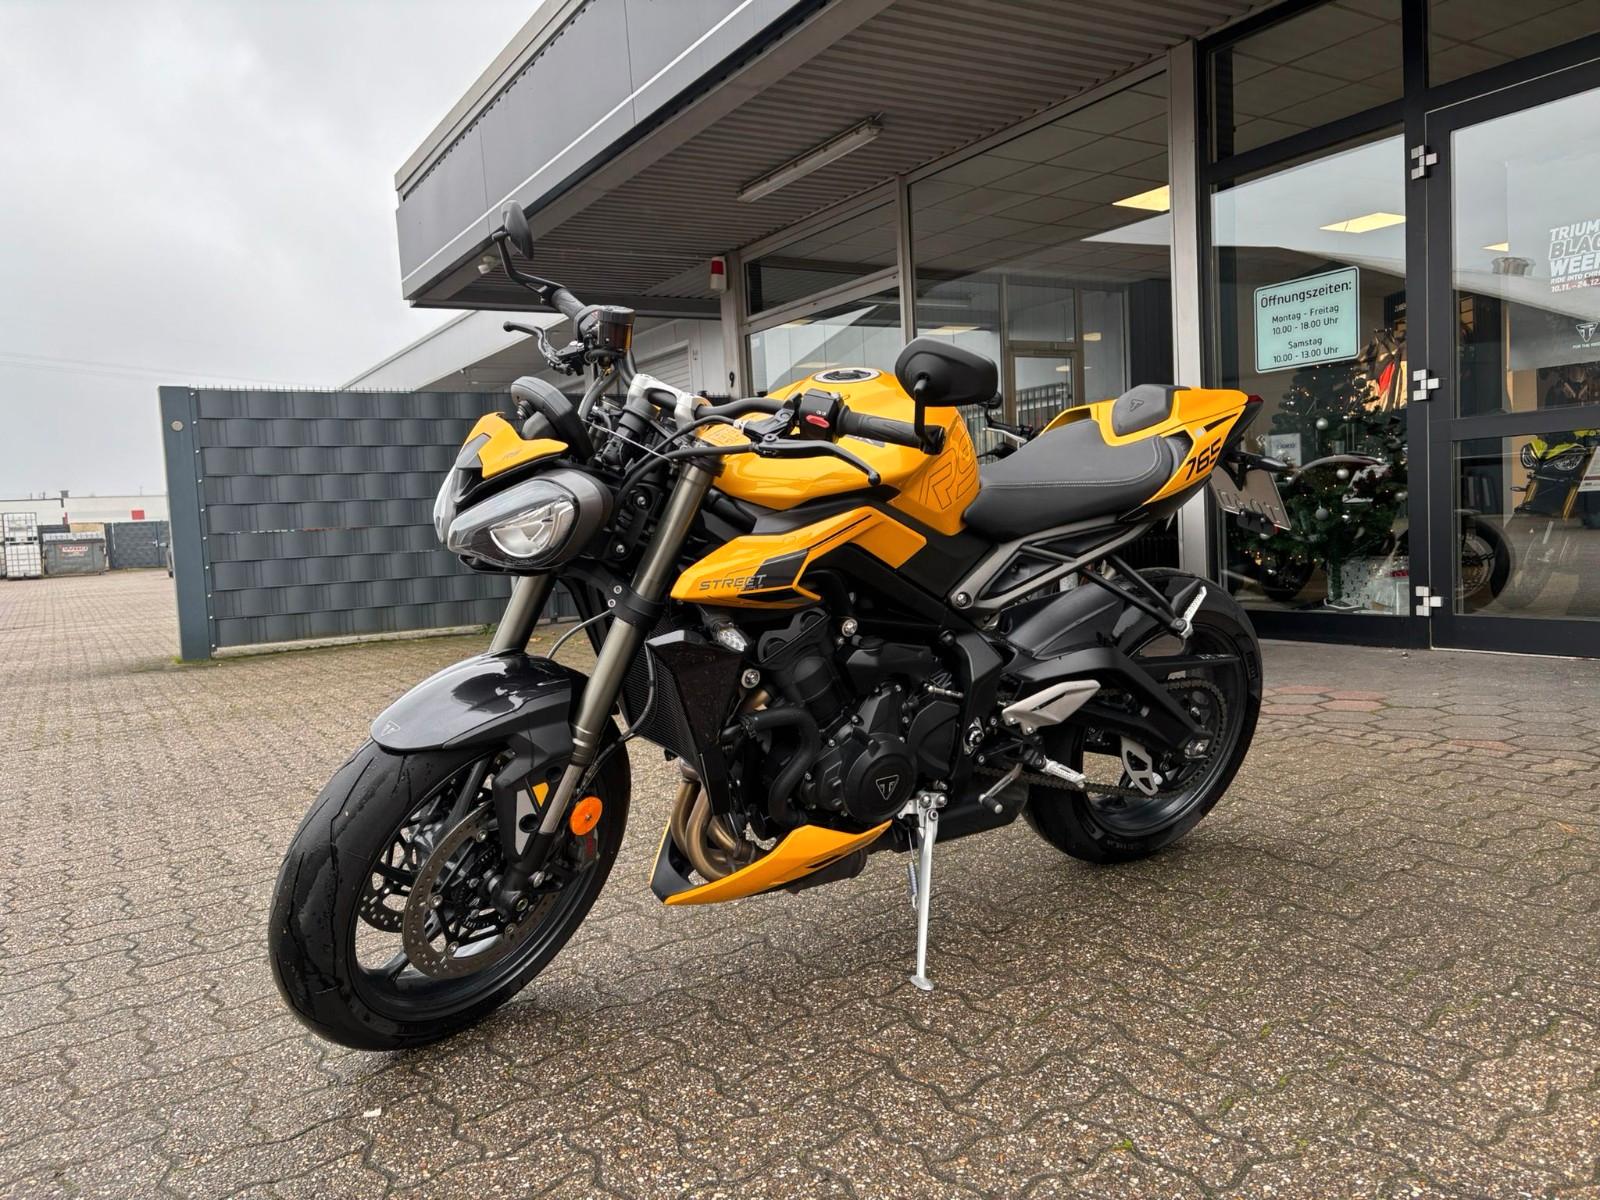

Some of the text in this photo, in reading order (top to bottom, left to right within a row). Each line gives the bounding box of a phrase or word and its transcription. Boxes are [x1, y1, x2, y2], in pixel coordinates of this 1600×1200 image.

[1271, 313, 1301, 324] Montag
[1309, 304, 1340, 316] Freitag
[1272, 325, 1293, 335] 10.00
[1300, 321, 1321, 331] 18.00
[1323, 316, 1338, 326] Uhr
[1287, 337, 1323, 350] Samstag
[1273, 353, 1293, 363] 10.00
[1301, 349, 1322, 359] 13.00
[1323, 346, 1339, 355] Uhr
[1186, 438, 1222, 481] 765
[700, 574, 767, 591] STREET
